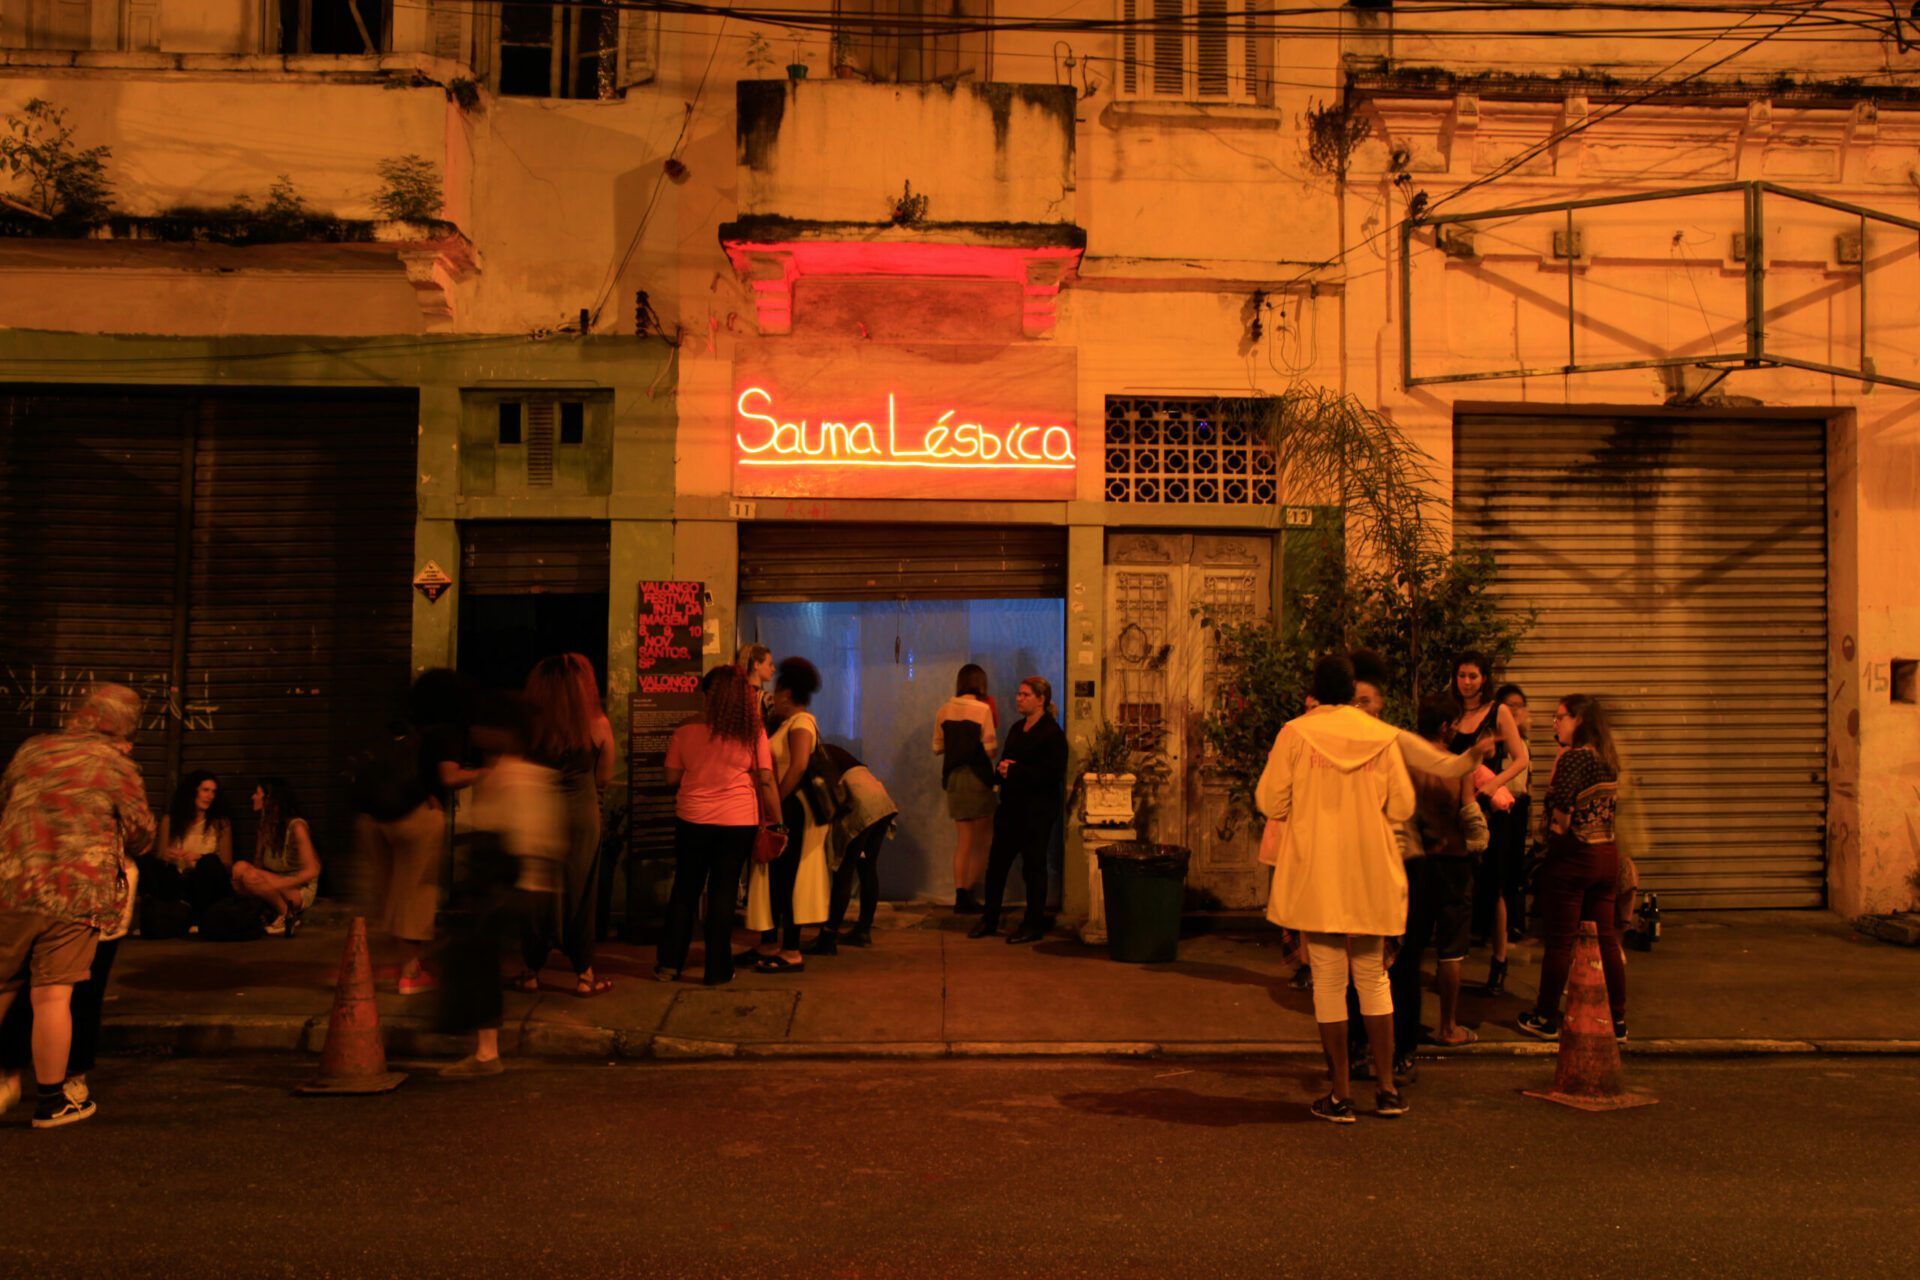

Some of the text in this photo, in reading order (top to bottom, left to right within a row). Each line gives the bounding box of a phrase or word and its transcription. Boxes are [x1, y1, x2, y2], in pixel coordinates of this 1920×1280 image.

[737, 388, 1076, 460] Sauna Lésbica
[735, 504, 750, 515] 11
[639, 582, 700, 593] VALONGO
[643, 592, 696, 604] FESTIVAL
[685, 602, 703, 615] DA
[639, 614, 689, 626] IMAGEM
[689, 626, 702, 637] 10
[639, 646, 692, 660] SANTOS,
[639, 658, 656, 669] SP
[638, 675, 699, 687] VALONGO
[1862, 661, 1889, 692] 15
